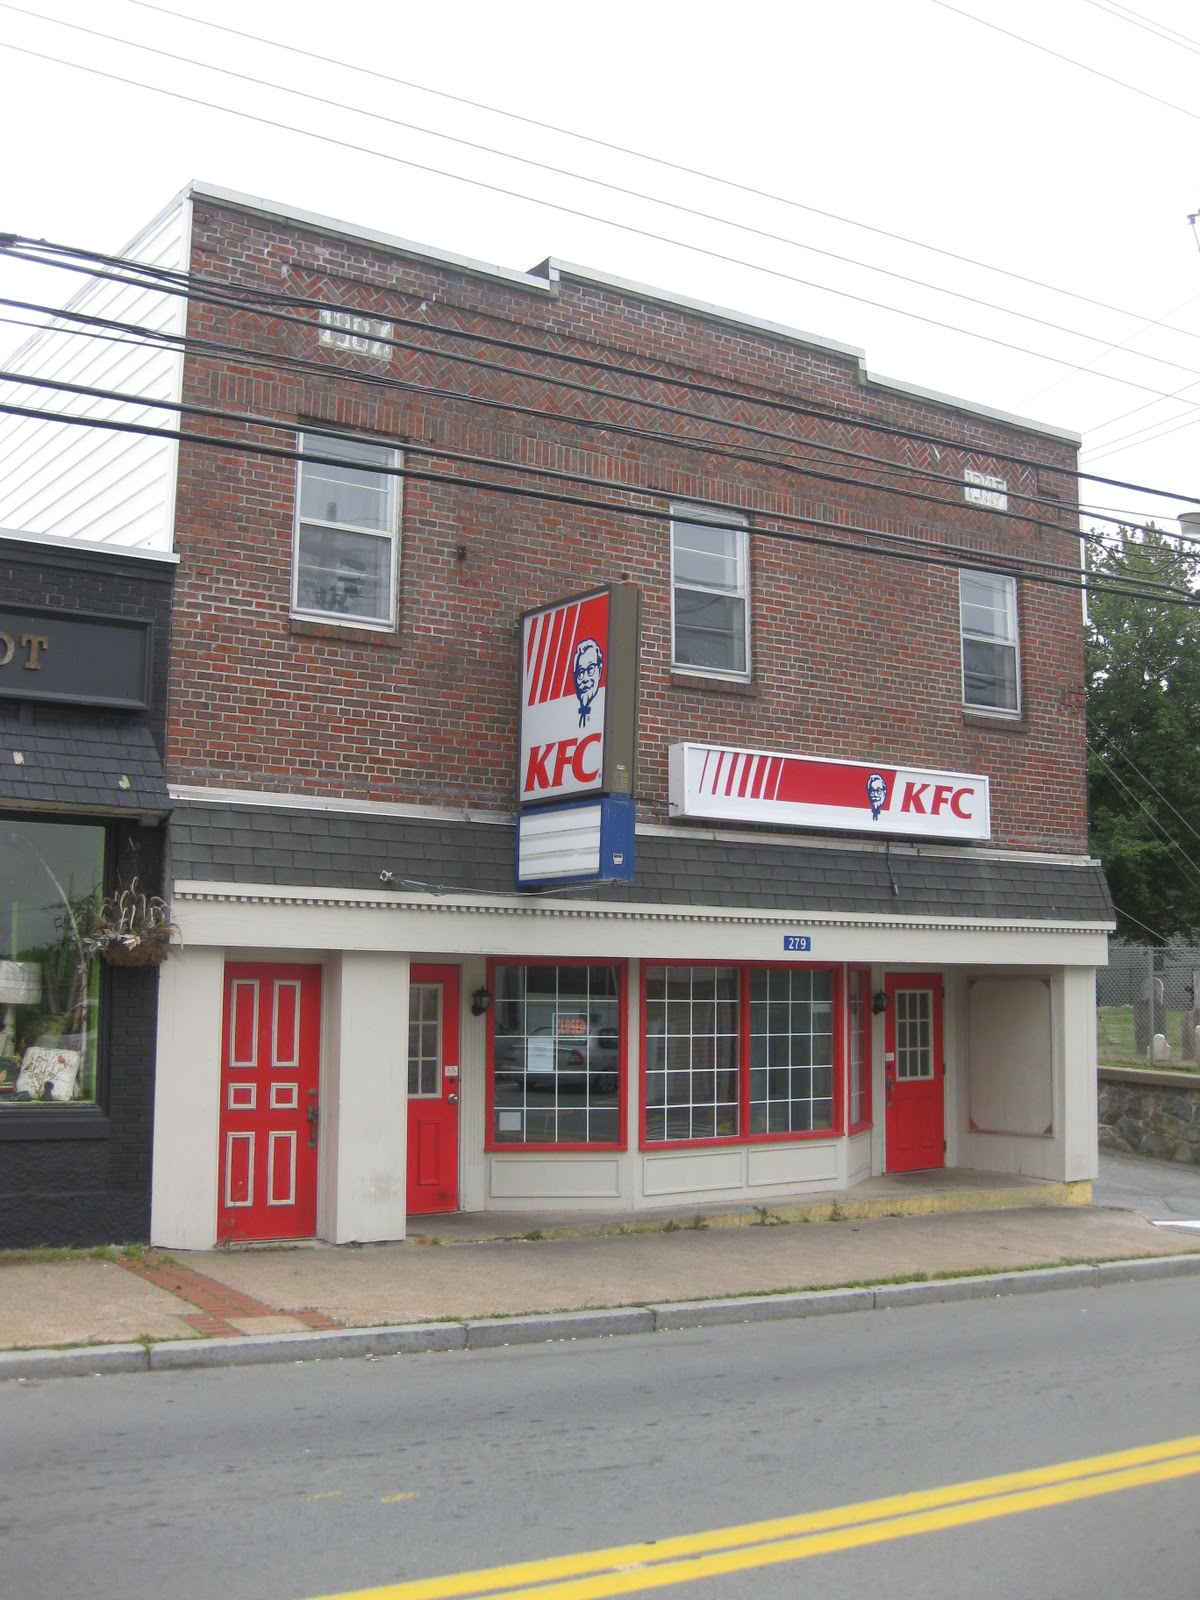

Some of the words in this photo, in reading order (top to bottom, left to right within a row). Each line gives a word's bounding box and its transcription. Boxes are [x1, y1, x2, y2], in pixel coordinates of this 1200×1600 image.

[523, 732, 602, 792] KFC
[900, 781, 975, 820] KFC
[788, 937, 807, 950] 279
